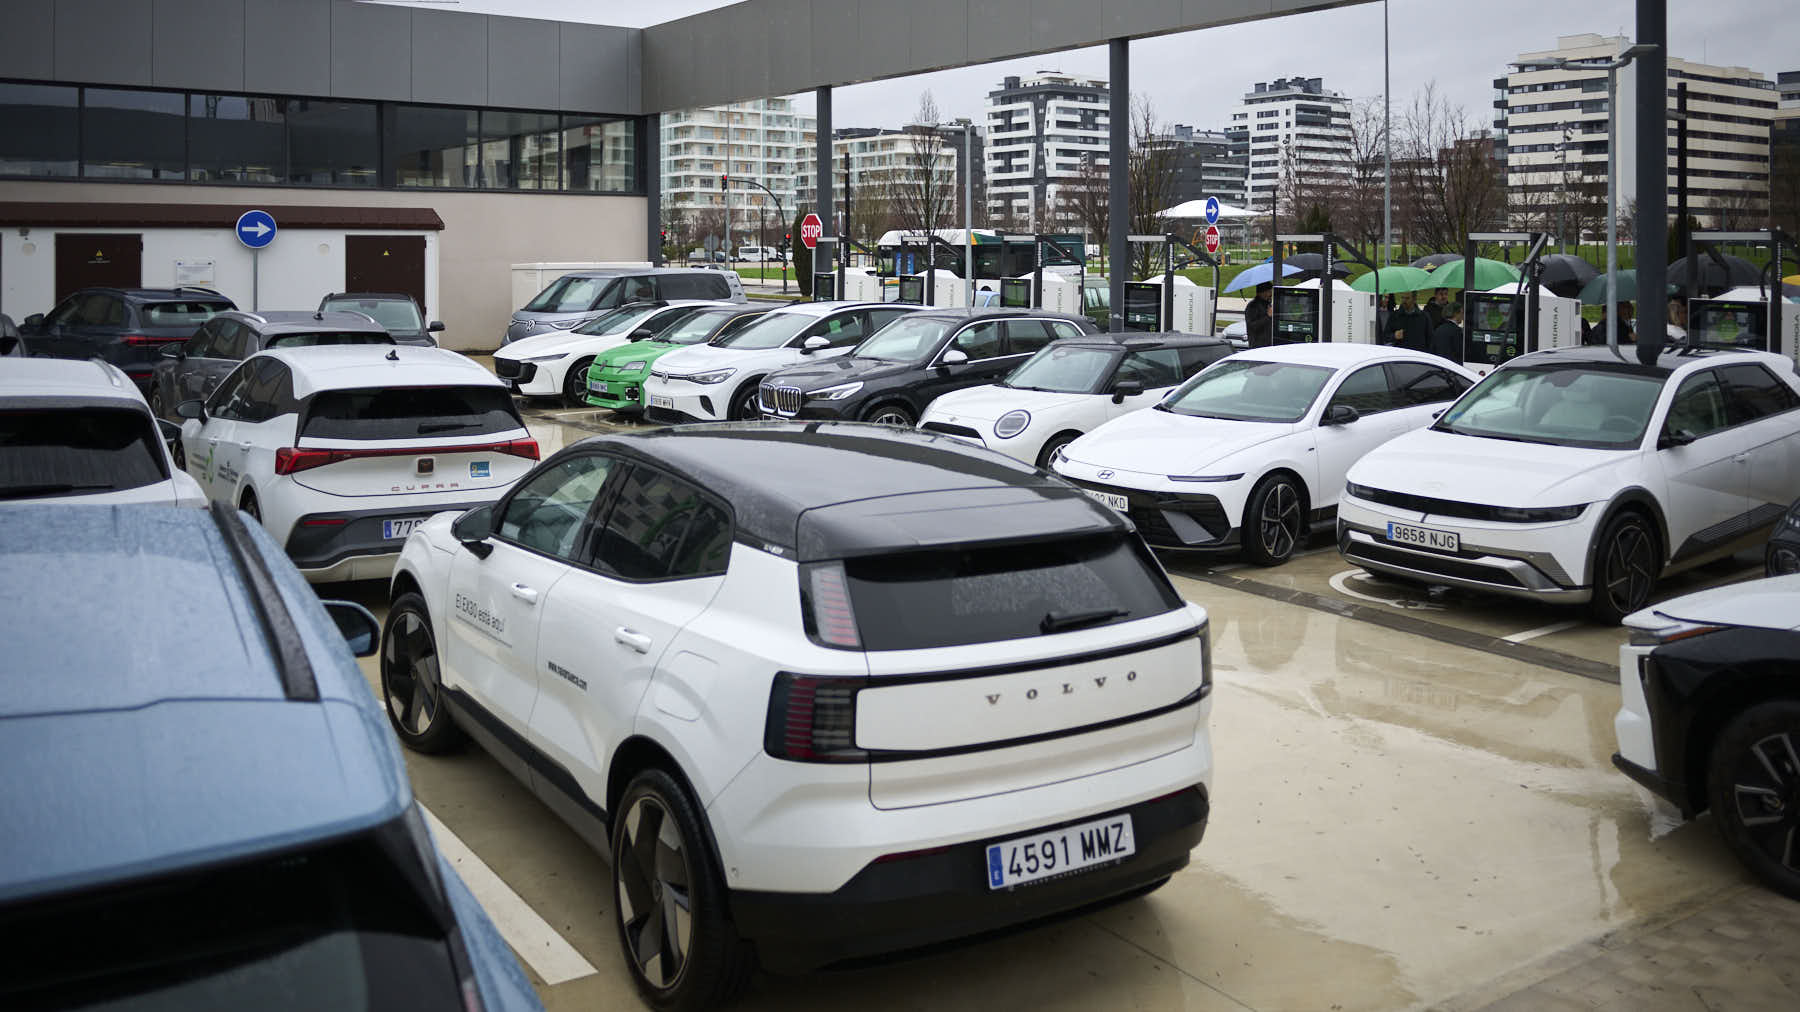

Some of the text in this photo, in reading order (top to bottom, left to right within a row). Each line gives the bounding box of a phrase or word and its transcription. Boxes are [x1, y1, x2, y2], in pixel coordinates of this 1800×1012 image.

[802, 224, 821, 238] STOP
[1206, 234, 1218, 245] STOP
[1108, 495, 1126, 509] NKD
[1395, 526, 1455, 549] 9658 NJG
[462, 597, 477, 619] EX30
[985, 671, 1137, 705] VOLVO
[1009, 835, 1070, 878] 4591
[1080, 822, 1128, 862] MMZ
